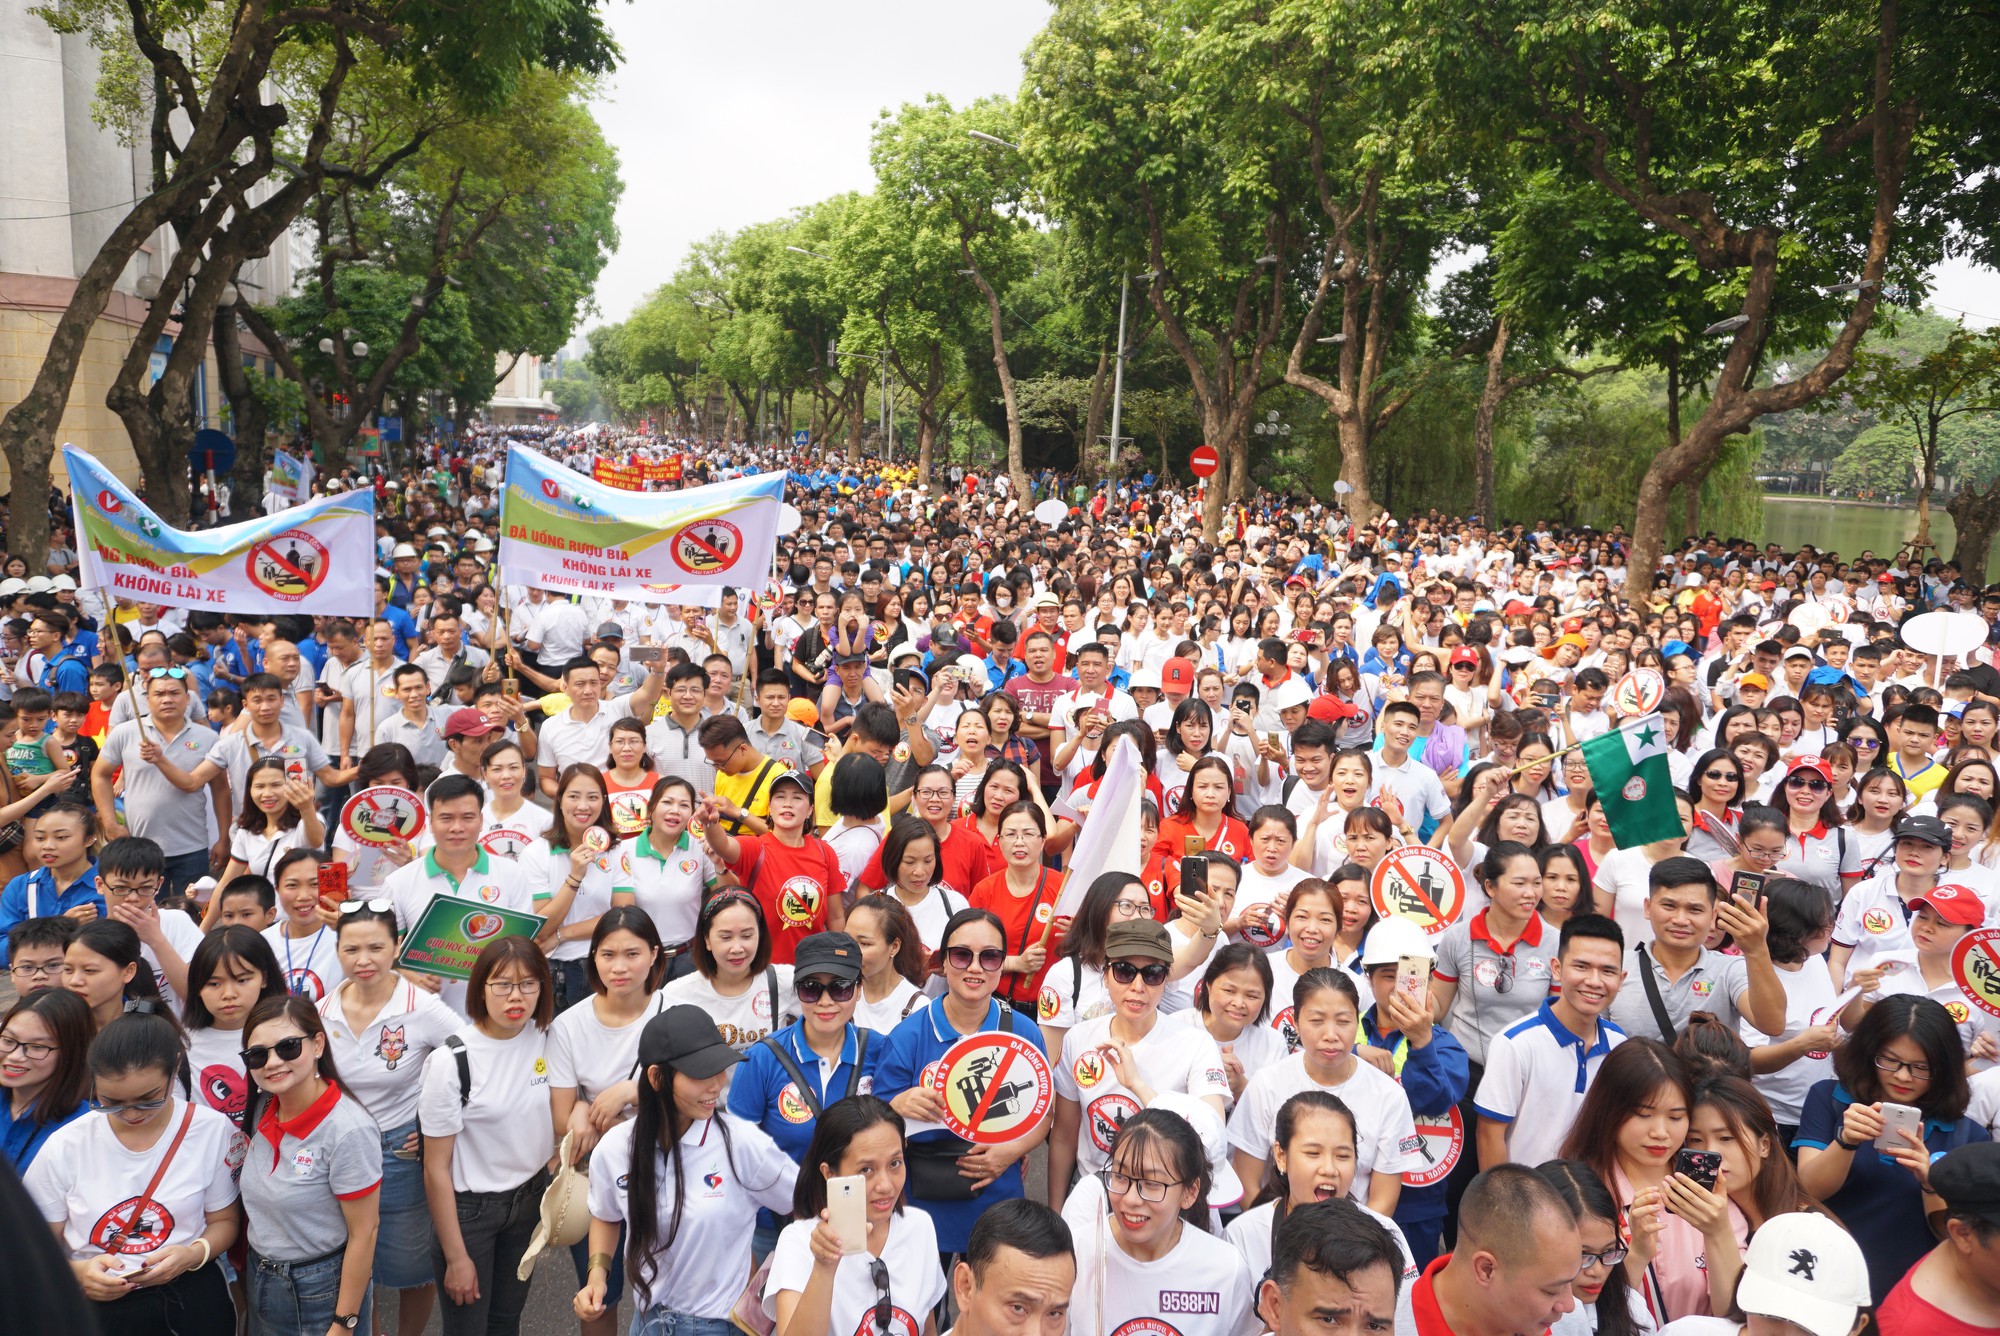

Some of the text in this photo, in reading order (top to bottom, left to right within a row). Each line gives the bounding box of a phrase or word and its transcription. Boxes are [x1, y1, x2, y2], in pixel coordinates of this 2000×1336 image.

[510, 524, 629, 561] ĐÃ UỐNG RƯỢU BIA
[171, 566, 198, 579] BIA
[562, 557, 652, 579] KHÔNG LÁI XE
[114, 572, 226, 603] KHÔNG LÁI XE
[1388, 847, 1455, 872] ĐÃ UỐNG RƯỢU, BIA
[1437, 919, 1450, 930] XE
[1973, 933, 1986, 942] ĐÃ
[445, 942, 463, 955] HỌC
[1961, 985, 1999, 1016] KHÔNG
[717, 1023, 768, 1046] Dior
[1010, 1040, 1049, 1114] ĐÃ UỐNG RƯỢU, BIA
[959, 1128, 975, 1140] XE
[1410, 1127, 1461, 1182] ĐÃ UỐNG RƯỢU, BIA
[108, 1210, 117, 1220] ĐÃ
[133, 1243, 150, 1252] LÁI
[151, 1238, 163, 1247] XE
[1162, 1291, 1218, 1312] 9598HN
[898, 1313, 909, 1324] BIA
[1126, 1322, 1145, 1333] UỐNG
[1146, 1322, 1167, 1336] RƯỢU,
